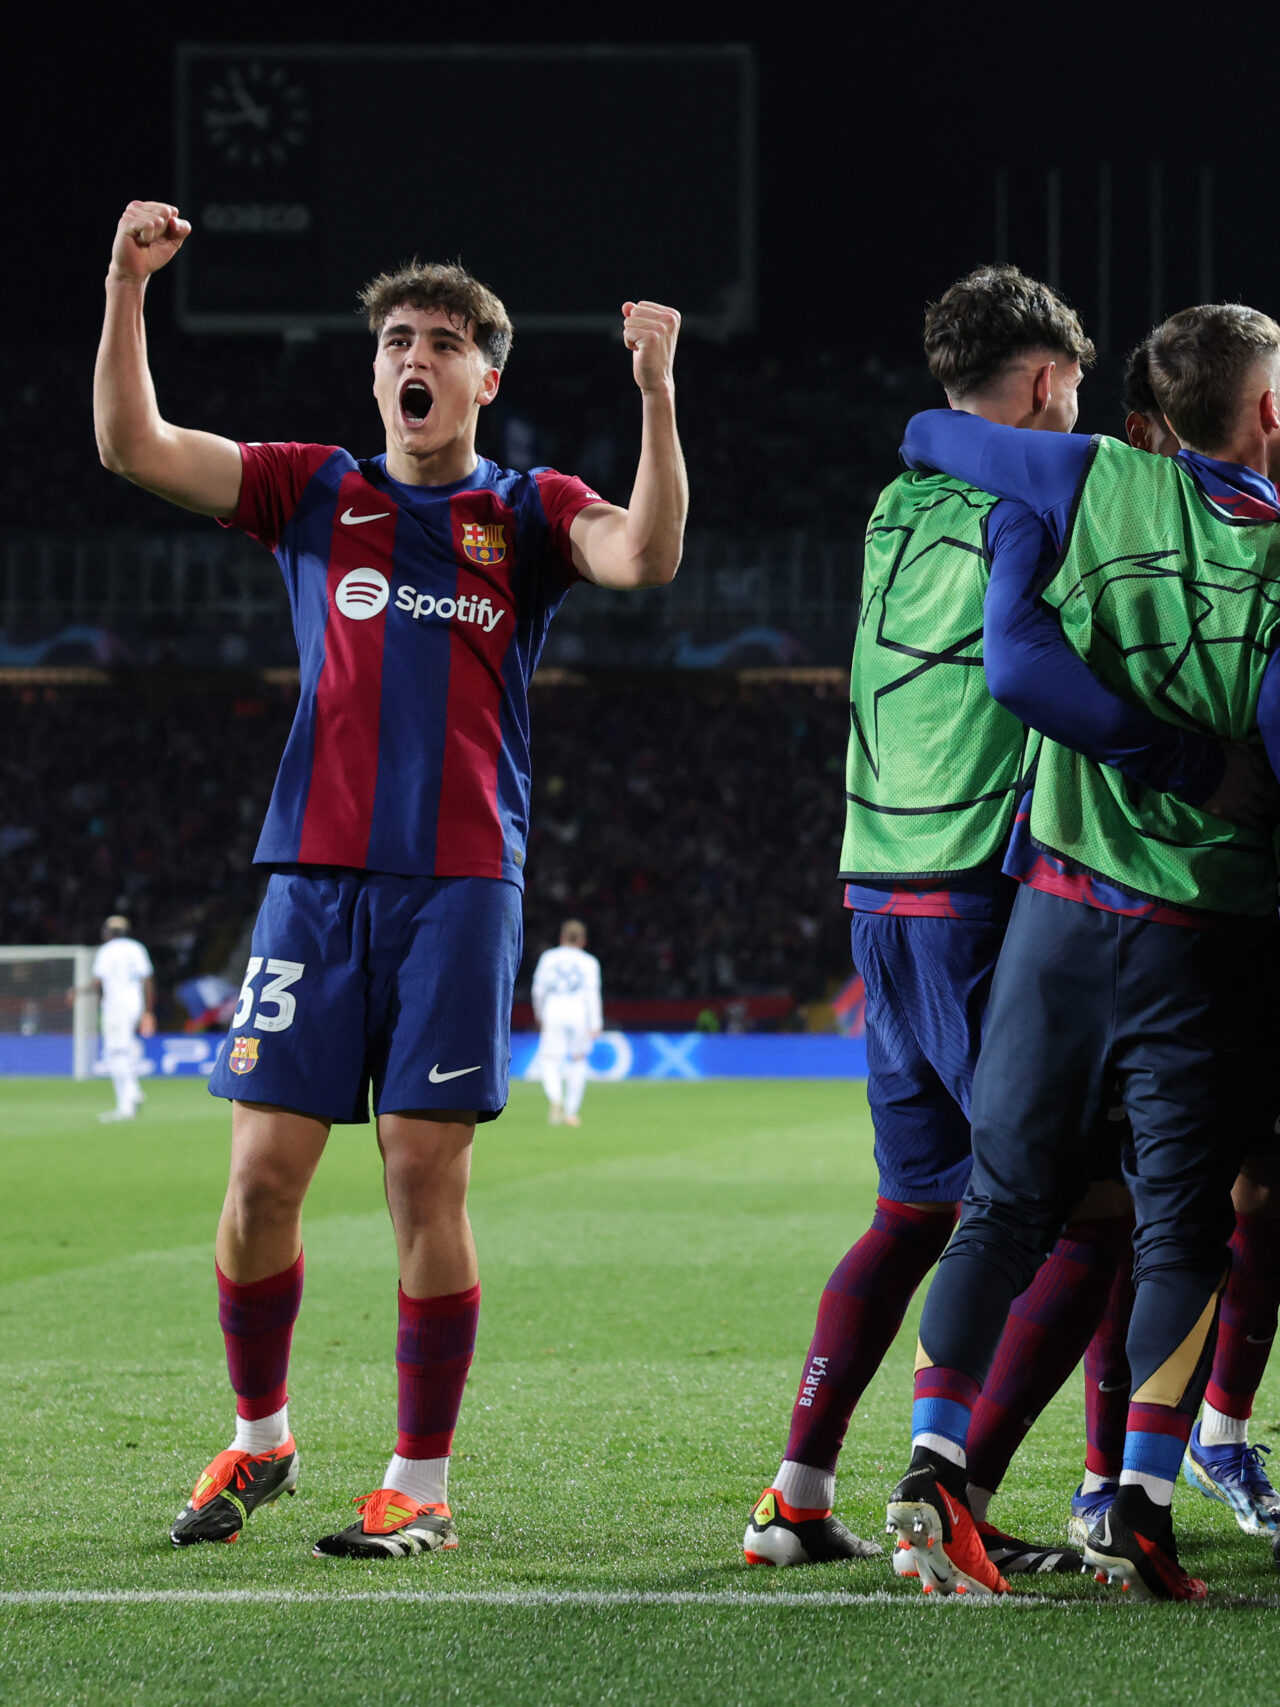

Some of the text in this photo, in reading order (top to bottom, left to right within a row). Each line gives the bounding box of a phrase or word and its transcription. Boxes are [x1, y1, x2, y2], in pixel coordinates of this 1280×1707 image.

[394, 585, 506, 633] Spotify
[232, 956, 306, 1033] 33
[798, 1356, 829, 1408] BARÇA
